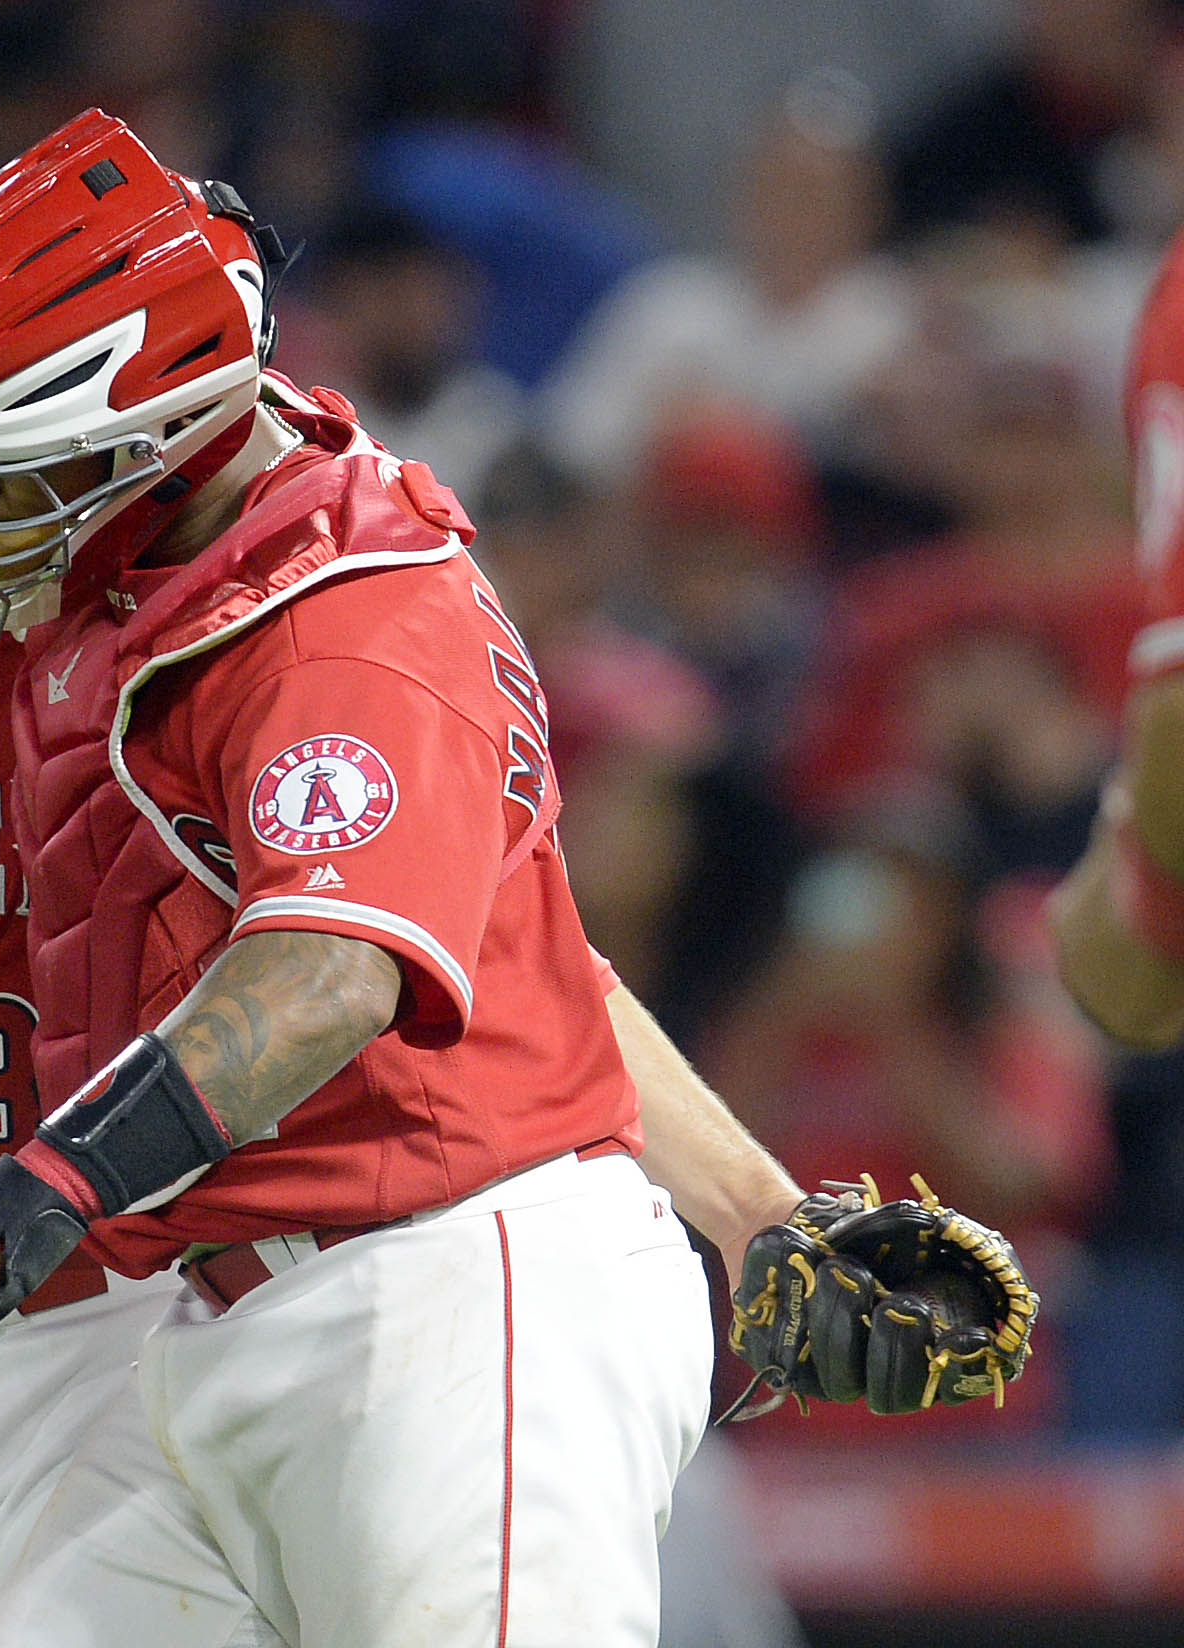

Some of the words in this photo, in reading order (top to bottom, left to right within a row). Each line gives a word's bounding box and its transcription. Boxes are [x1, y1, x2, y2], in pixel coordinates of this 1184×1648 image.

[269, 740, 367, 779] ANGELS
[256, 799, 279, 820] 19
[300, 761, 348, 827] A
[365, 782, 389, 799] 61
[263, 809, 386, 848] BASEBALL
